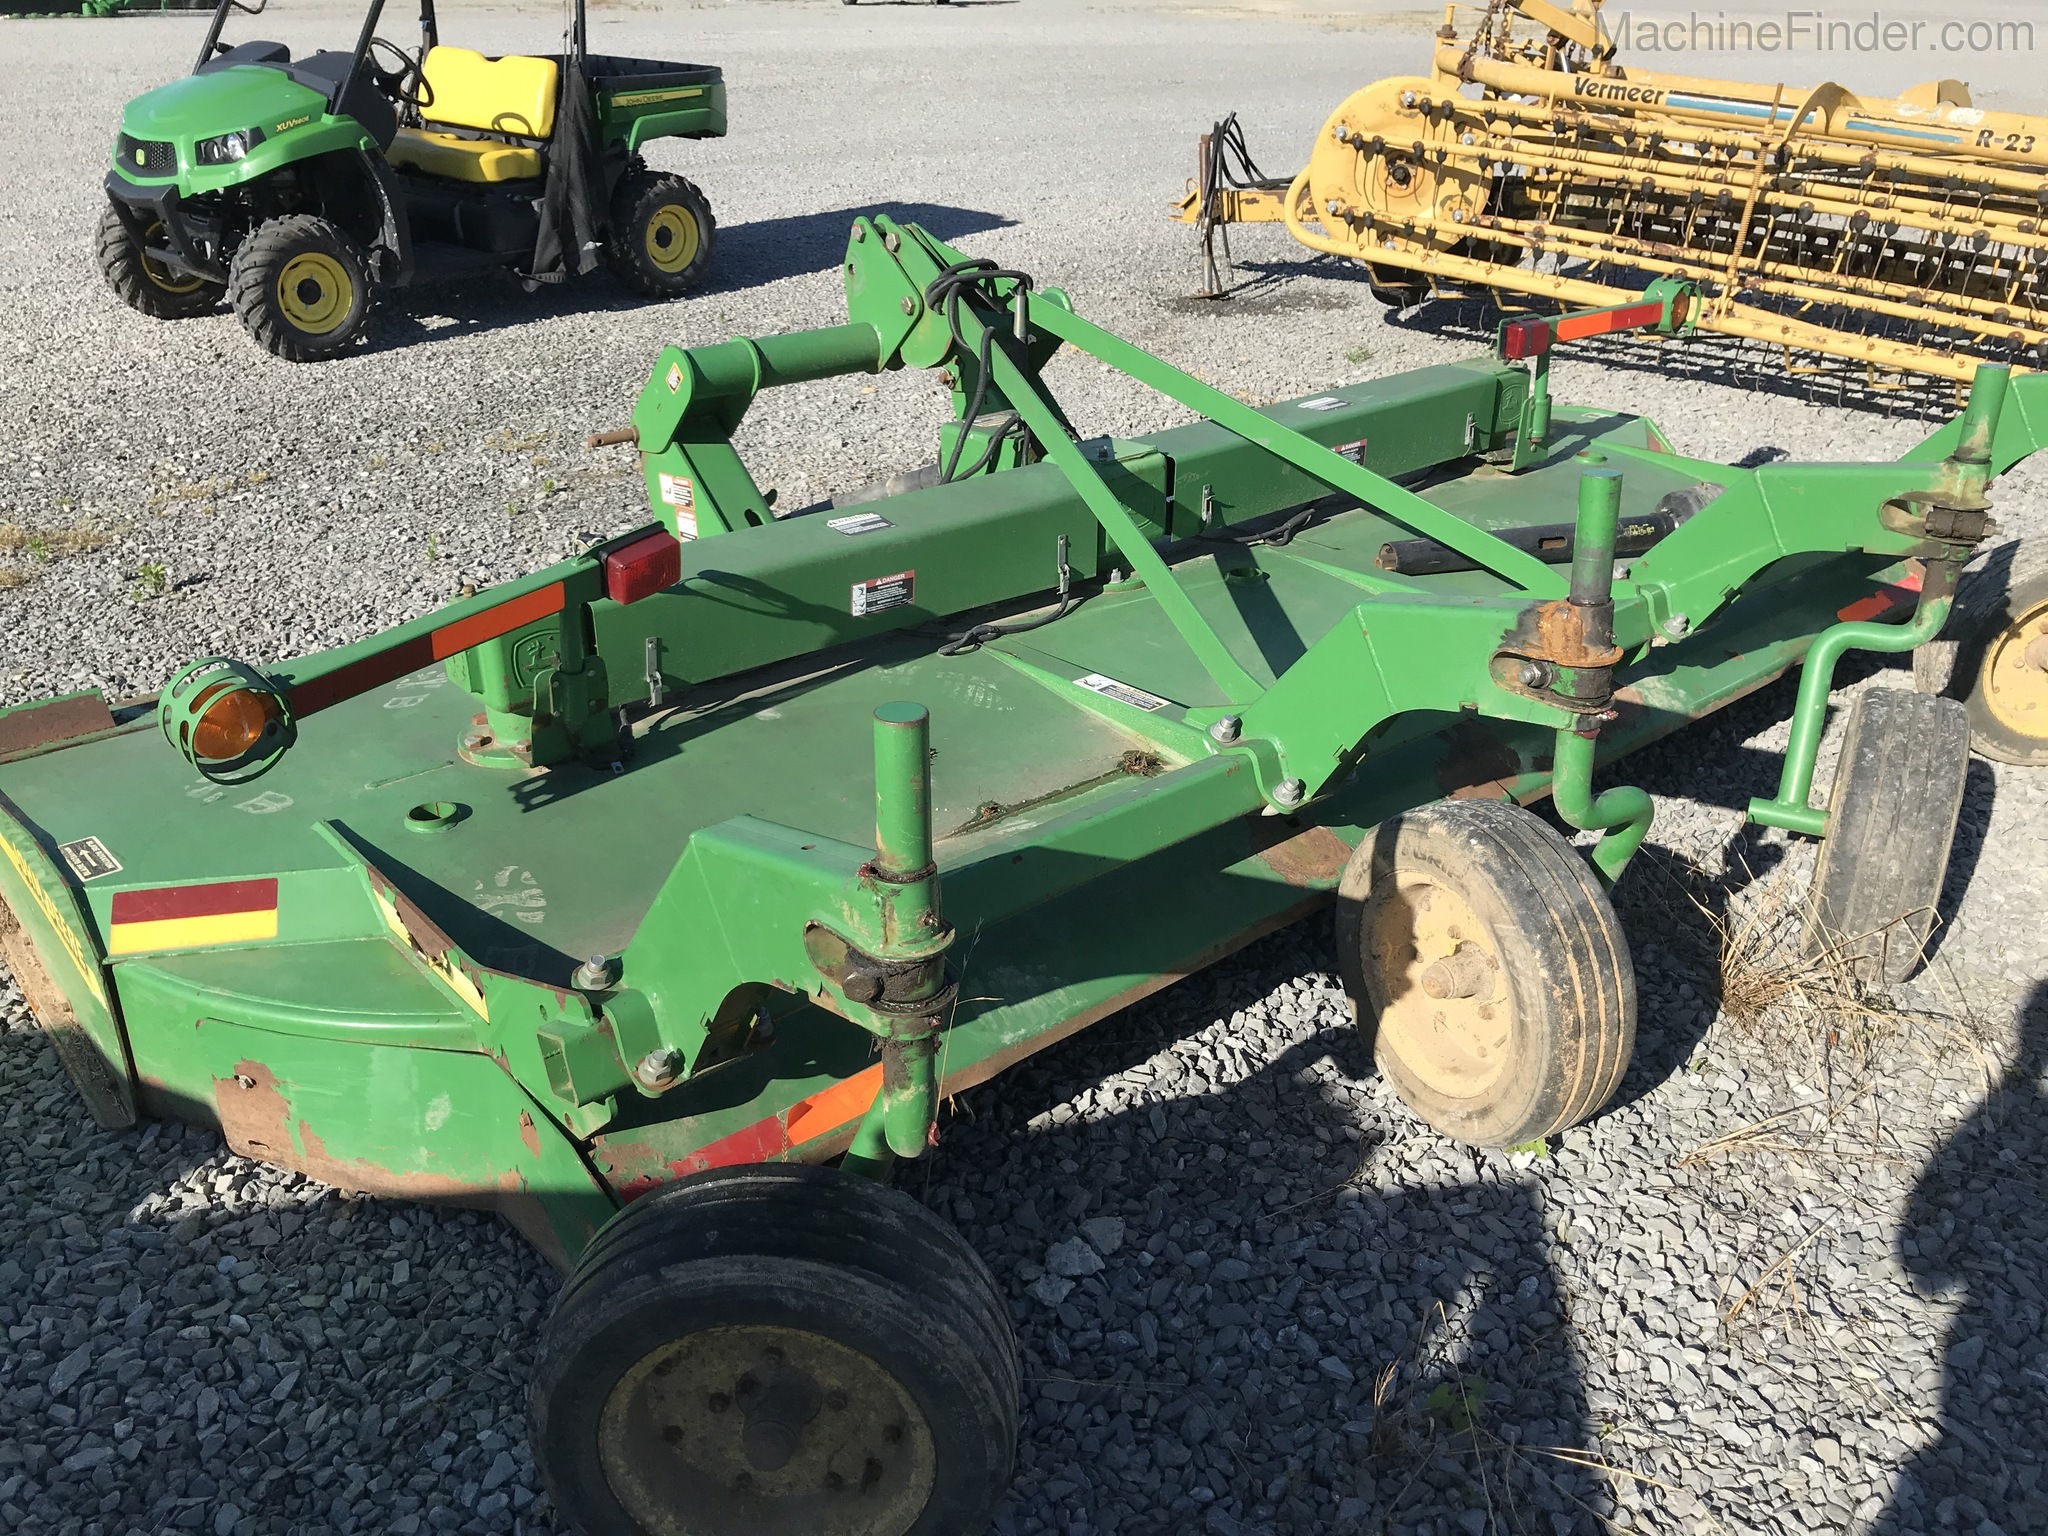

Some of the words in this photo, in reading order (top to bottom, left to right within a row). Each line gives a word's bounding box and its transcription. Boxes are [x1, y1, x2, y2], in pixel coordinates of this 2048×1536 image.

[1574, 76, 1665, 105] Vermeer
[1975, 128, 2036, 154] R-23
[882, 573, 906, 583] DANGER
